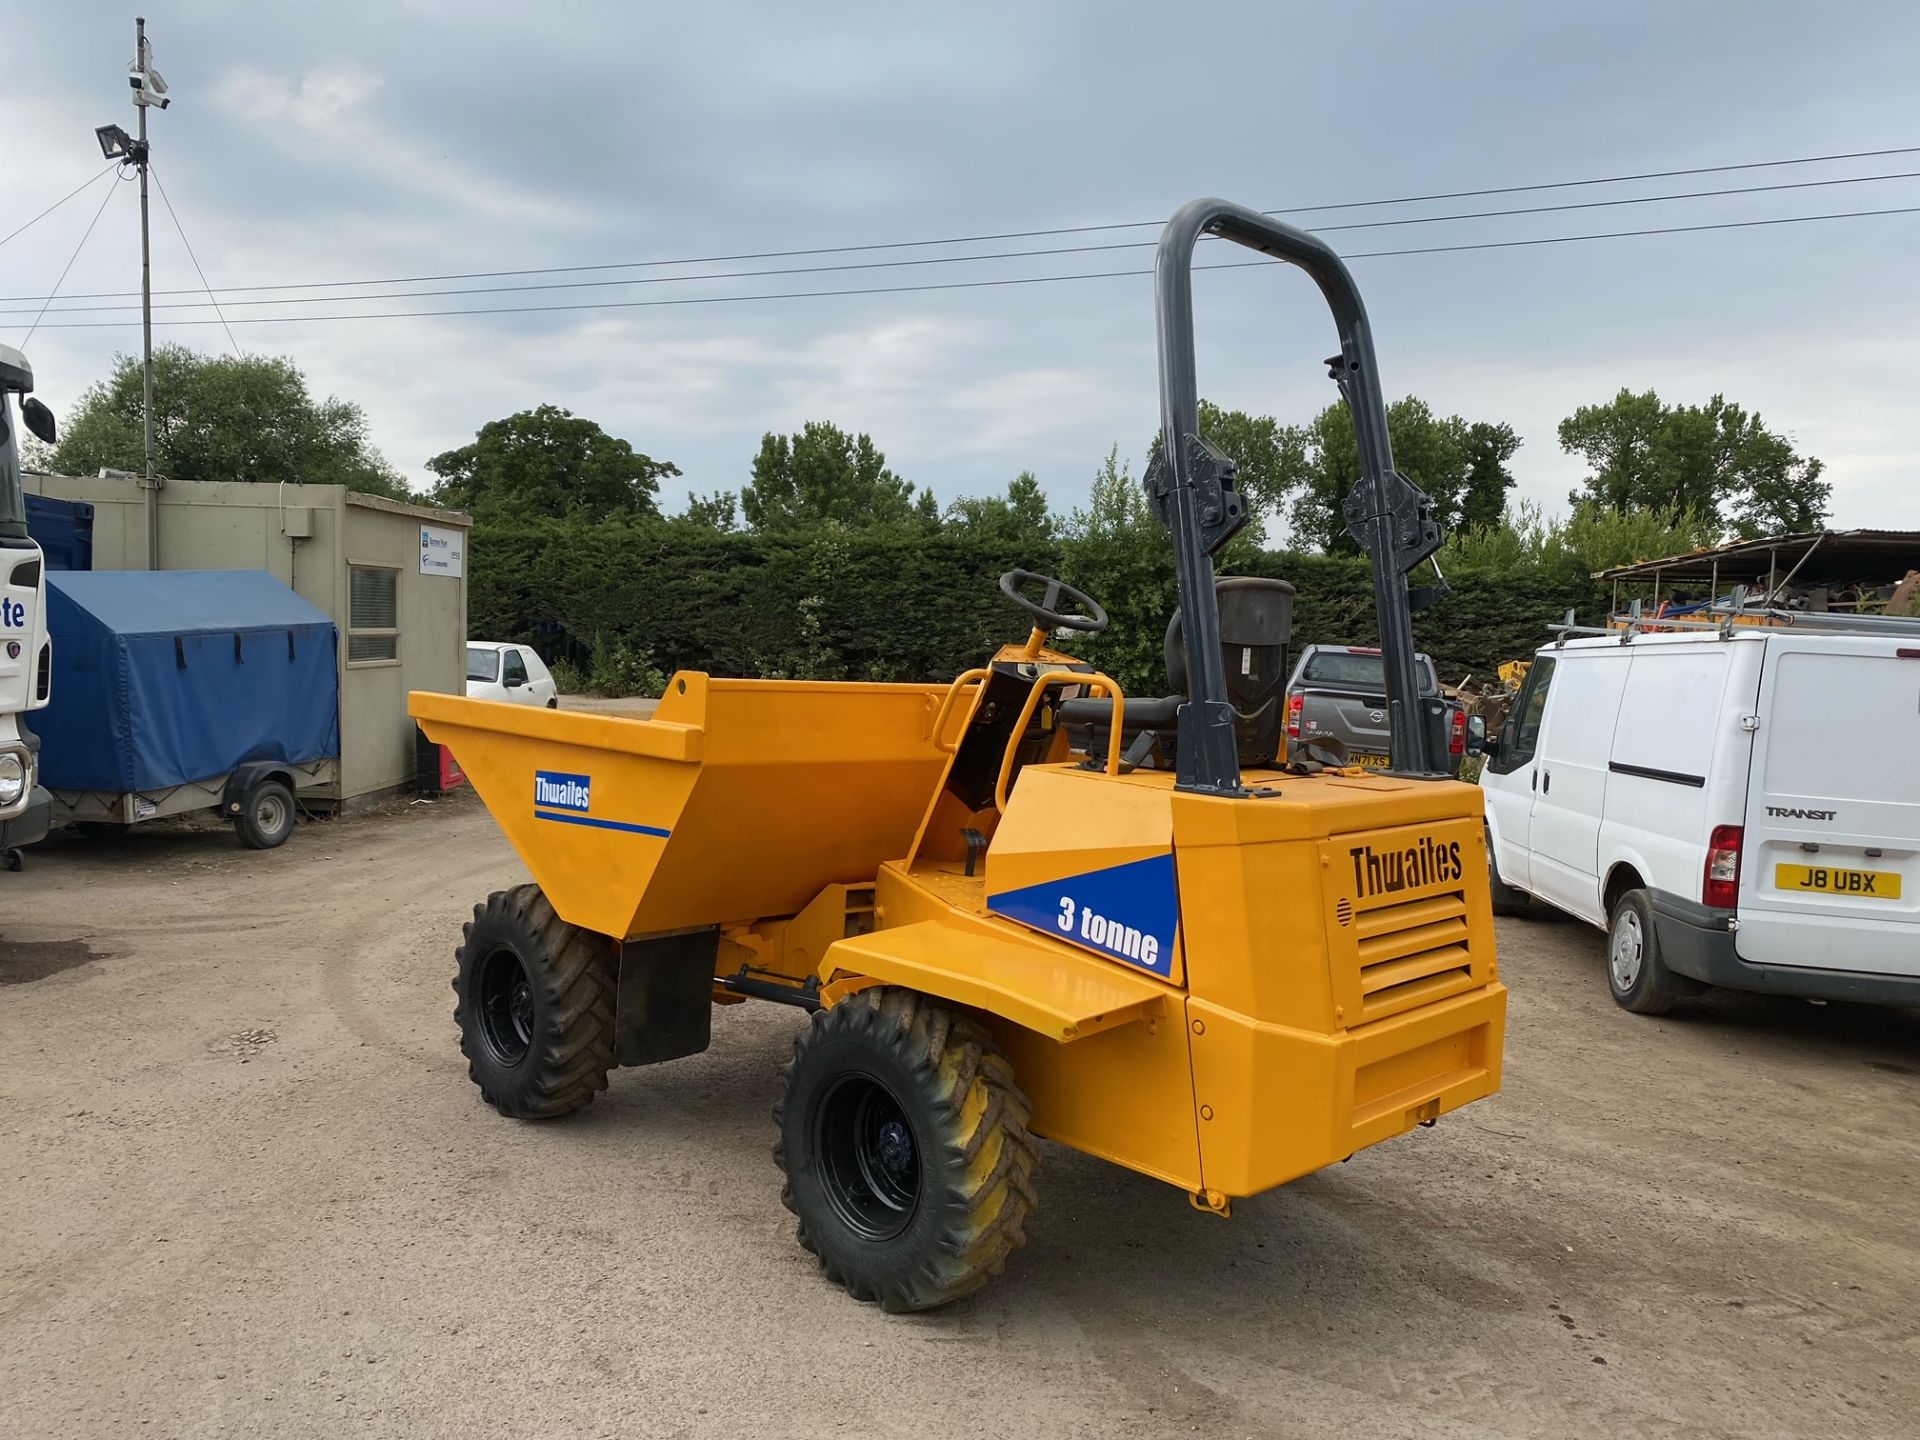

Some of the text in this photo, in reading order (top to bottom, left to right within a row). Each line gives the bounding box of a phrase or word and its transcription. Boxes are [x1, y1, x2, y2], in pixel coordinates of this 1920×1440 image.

[0, 596, 24, 628] te
[1371, 756, 1389, 767] XS
[535, 776, 589, 808] Thwaites
[1765, 806, 1837, 821] TRANSIT
[1349, 836, 1462, 898] Thwaites
[1799, 868, 1876, 893] J8 UBX
[1057, 895, 1159, 966] 3 tonne
